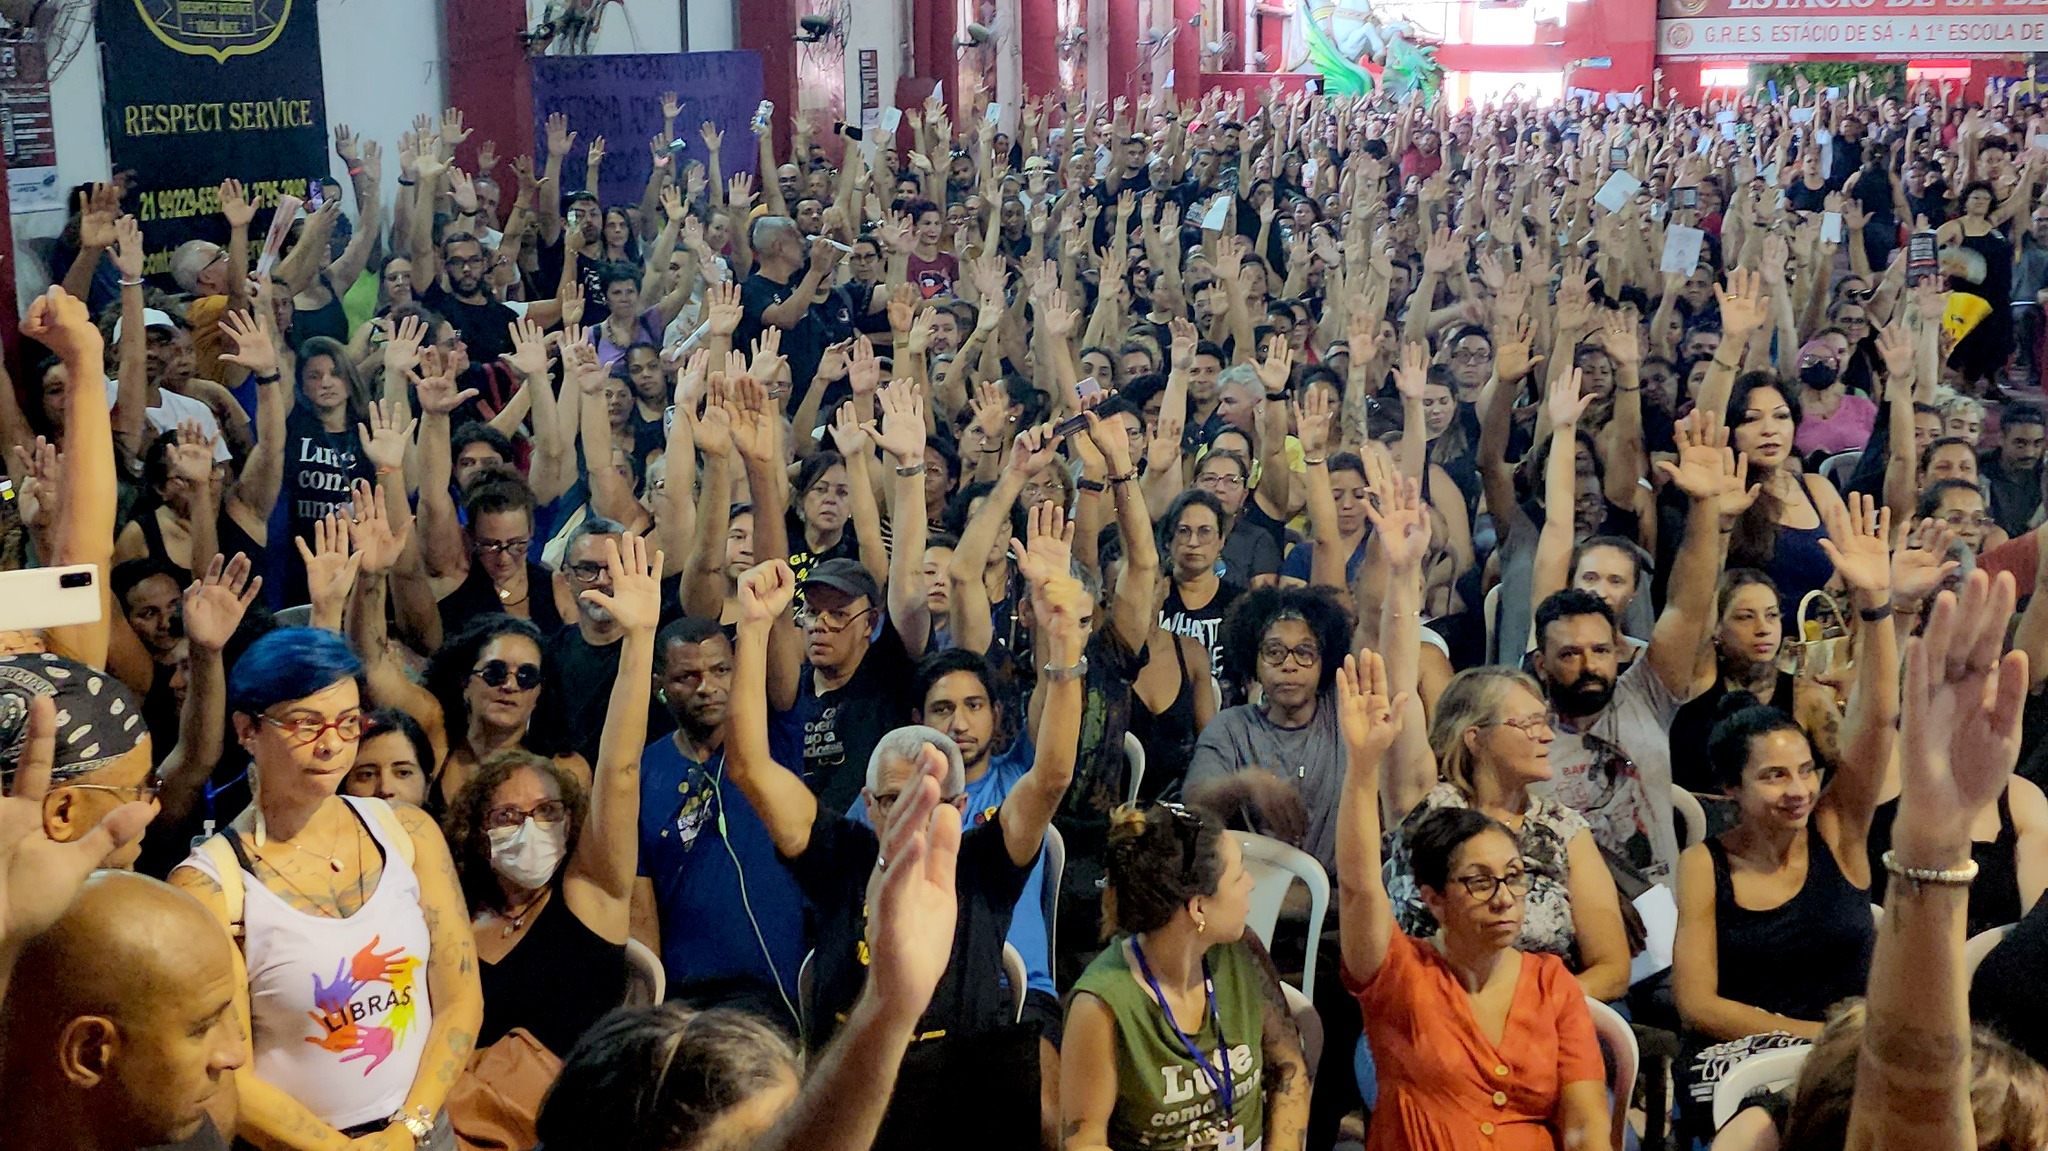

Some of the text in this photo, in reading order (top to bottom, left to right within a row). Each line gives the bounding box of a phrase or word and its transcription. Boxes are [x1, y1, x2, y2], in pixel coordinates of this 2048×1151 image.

[1705, 26, 1764, 43] G.R.E.S.
[1771, 20, 1839, 42] ESTÁCIO
[1845, 24, 1867, 41] DE
[1872, 19, 1894, 41] SÁ
[1908, 24, 1919, 41] A
[1948, 23, 2014, 41] ESCOLA
[2020, 22, 2045, 41] DE
[124, 102, 224, 137] RESPECT
[139, 192, 155, 221] 21
[322, 985, 412, 1033] LIBRAS
[1151, 1098, 1216, 1127] como
